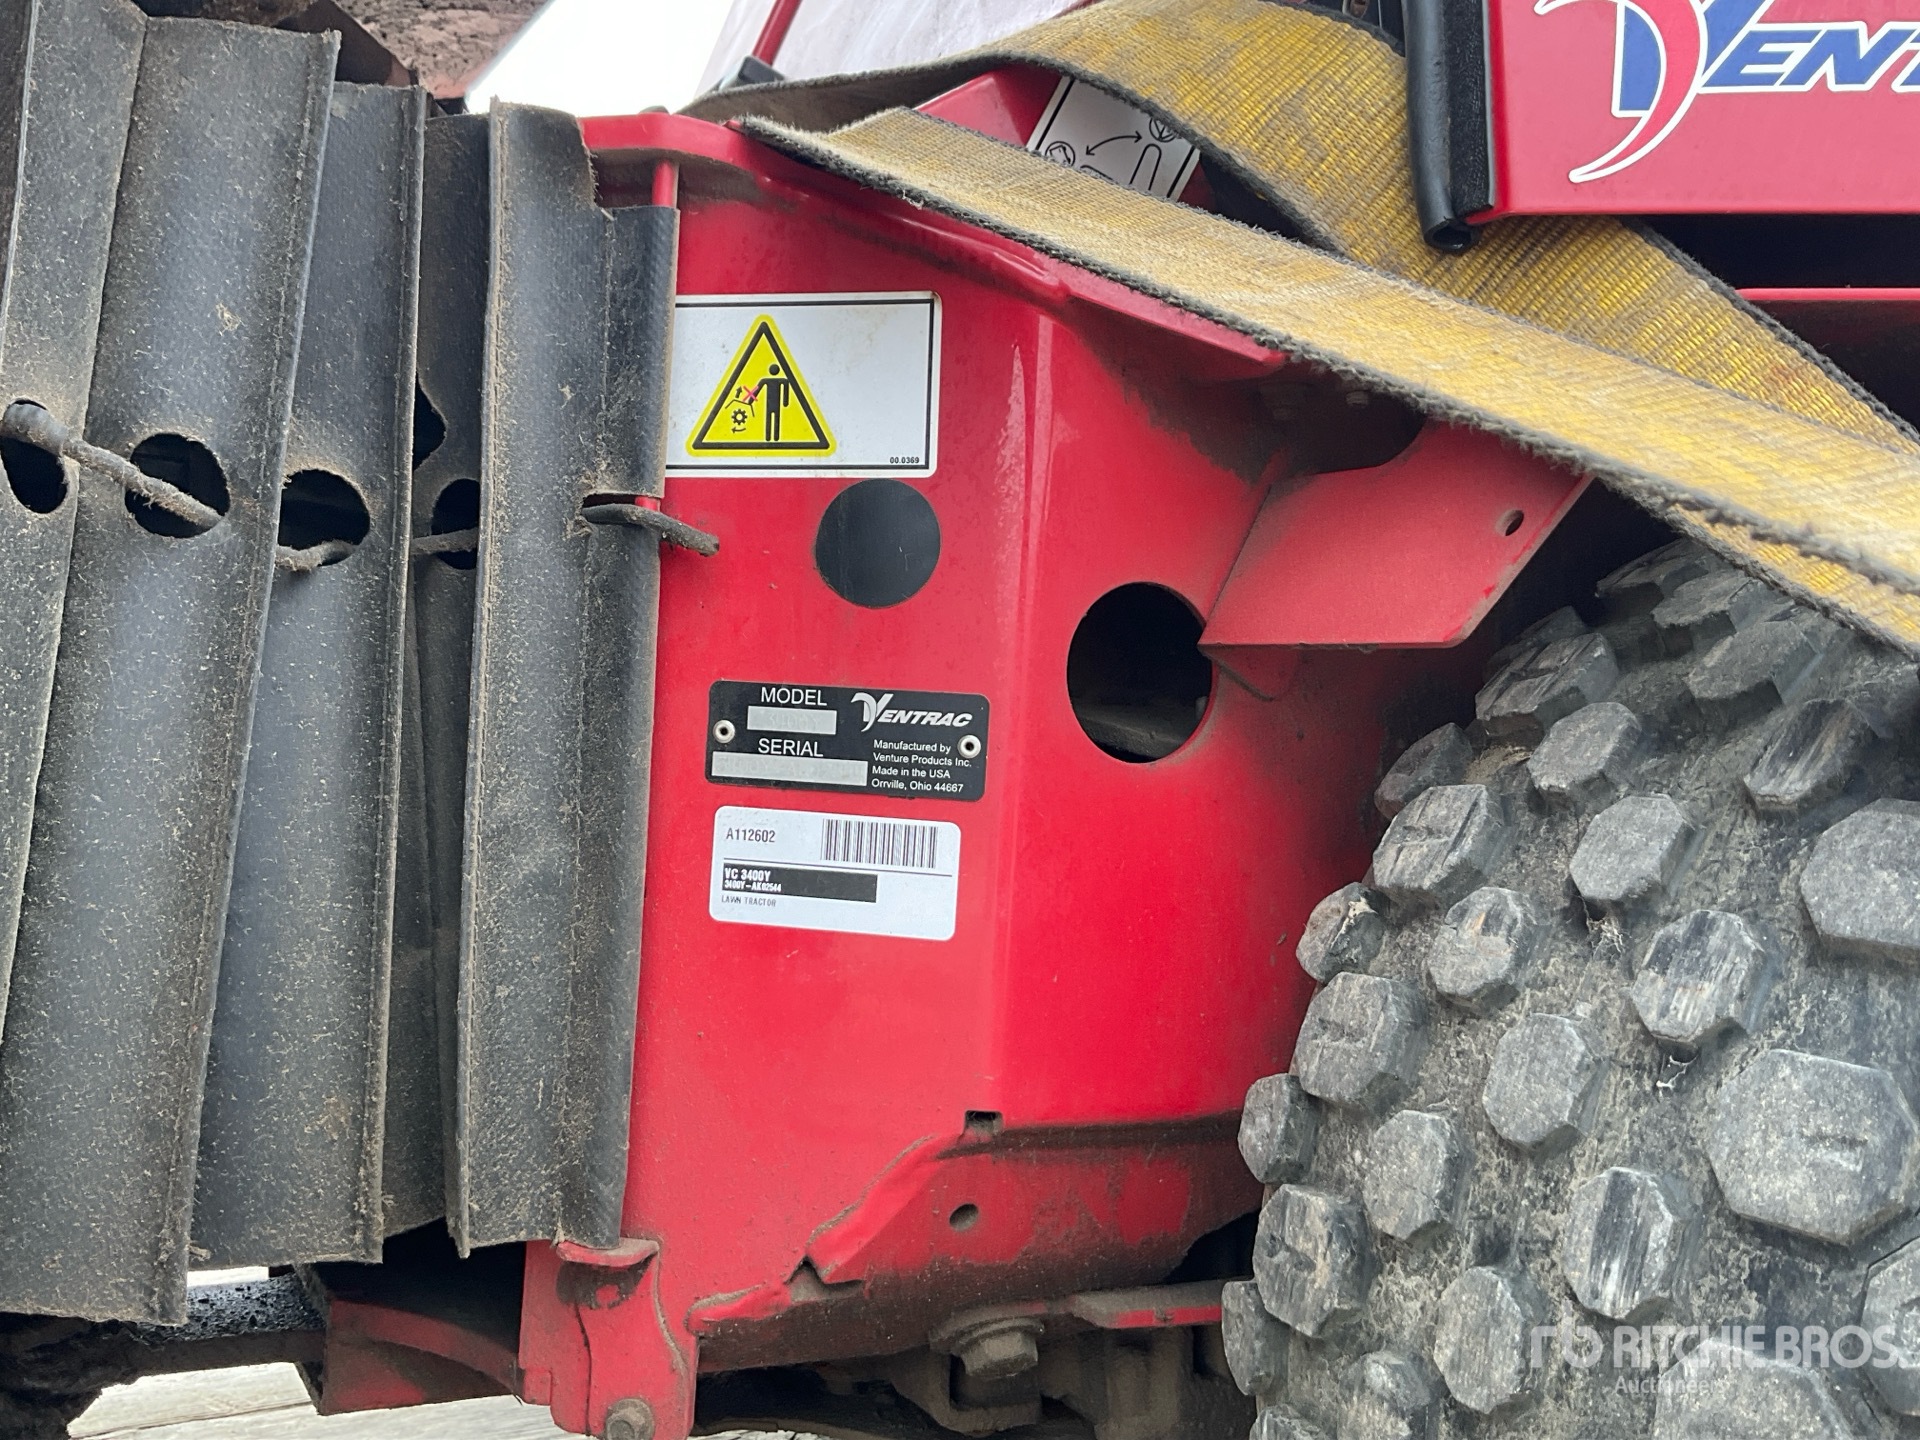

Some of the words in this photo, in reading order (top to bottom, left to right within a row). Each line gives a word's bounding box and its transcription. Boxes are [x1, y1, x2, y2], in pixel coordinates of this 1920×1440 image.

[889, 456, 920, 465] 00.0369
[761, 686, 828, 707] MODEL
[851, 692, 973, 732] VENTRAC
[758, 737, 824, 758] SERIAL
[873, 739, 938, 752] Manufactured
[939, 742, 952, 754] by
[873, 752, 909, 764] Venture
[911, 754, 953, 767] Products
[955, 757, 972, 768] Inc.
[872, 765, 899, 776] Made
[900, 767, 910, 777] in
[911, 767, 927, 778] the
[929, 769, 951, 779] USA
[871, 778, 907, 790] Orrville,
[909, 780, 932, 791] Ohio
[933, 783, 964, 793] 44667
[725, 828, 776, 843] A112602
[724, 867, 739, 880] VC
[740, 869, 771, 882] 3400Y
[721, 895, 742, 905] LAWN
[744, 897, 777, 908] TRACTOR
